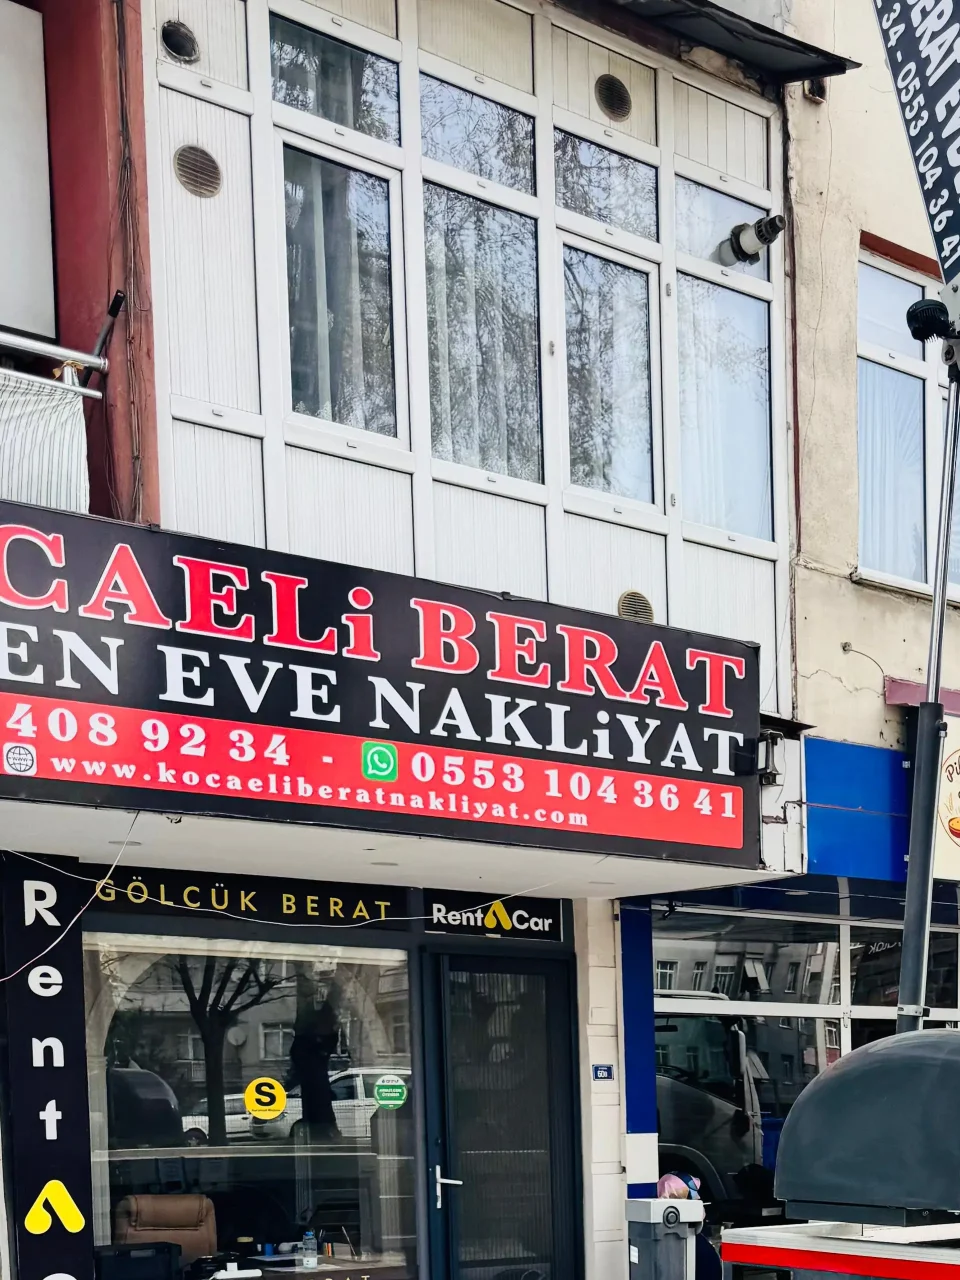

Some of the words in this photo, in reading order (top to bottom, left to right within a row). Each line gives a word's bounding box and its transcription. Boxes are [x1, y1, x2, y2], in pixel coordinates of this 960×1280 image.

[881, 2, 906, 48] 34
[897, 61, 929, 137] 0553
[915, 131, 943, 191] 104
[929, 188, 954, 233] 36
[0, 621, 125, 695] EN
[156, 644, 341, 723] EVE
[409, 597, 746, 719] BERAT
[6, 702, 119, 747] 408
[140, 718, 207, 758] 92
[228, 728, 291, 767] 34
[411, 751, 525, 793] 0553
[544, 768, 618, 804] 104
[633, 779, 680, 811] 36
[693, 788, 737, 819] 41
[50, 755, 589, 827] www.kocaeliberatnakliyat.com
[95, 875, 258, 913] GÖLCÜK
[282, 893, 391, 922] BERAT
[254, 1081, 277, 1107] S
